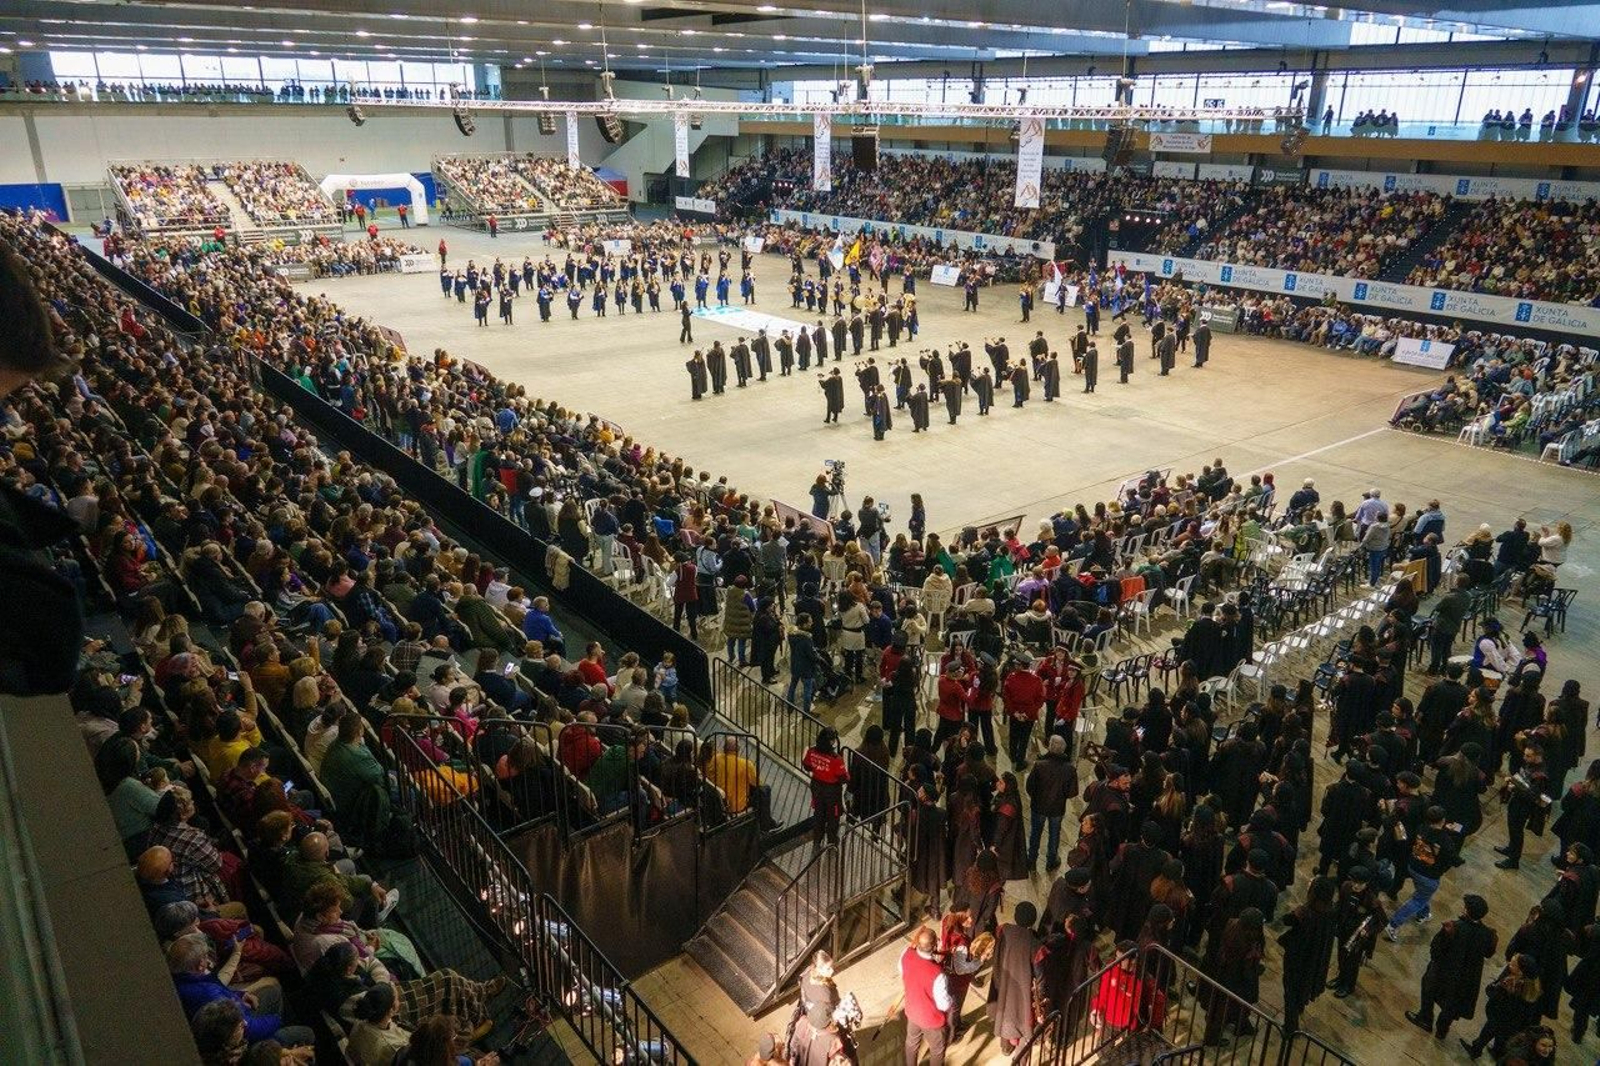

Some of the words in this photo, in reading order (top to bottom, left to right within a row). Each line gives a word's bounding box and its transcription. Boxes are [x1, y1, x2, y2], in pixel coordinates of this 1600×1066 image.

[1300, 276, 1324, 286] XUNTA
[1370, 285, 1398, 295] XUNTA
[1380, 295, 1413, 306] GALICIA
[1449, 296, 1479, 306] XUNTA
[1460, 305, 1497, 317] GALICIA
[1536, 306, 1569, 317] XUNTA
[1533, 314, 1545, 323] DE
[1548, 316, 1588, 329] GALICIA
